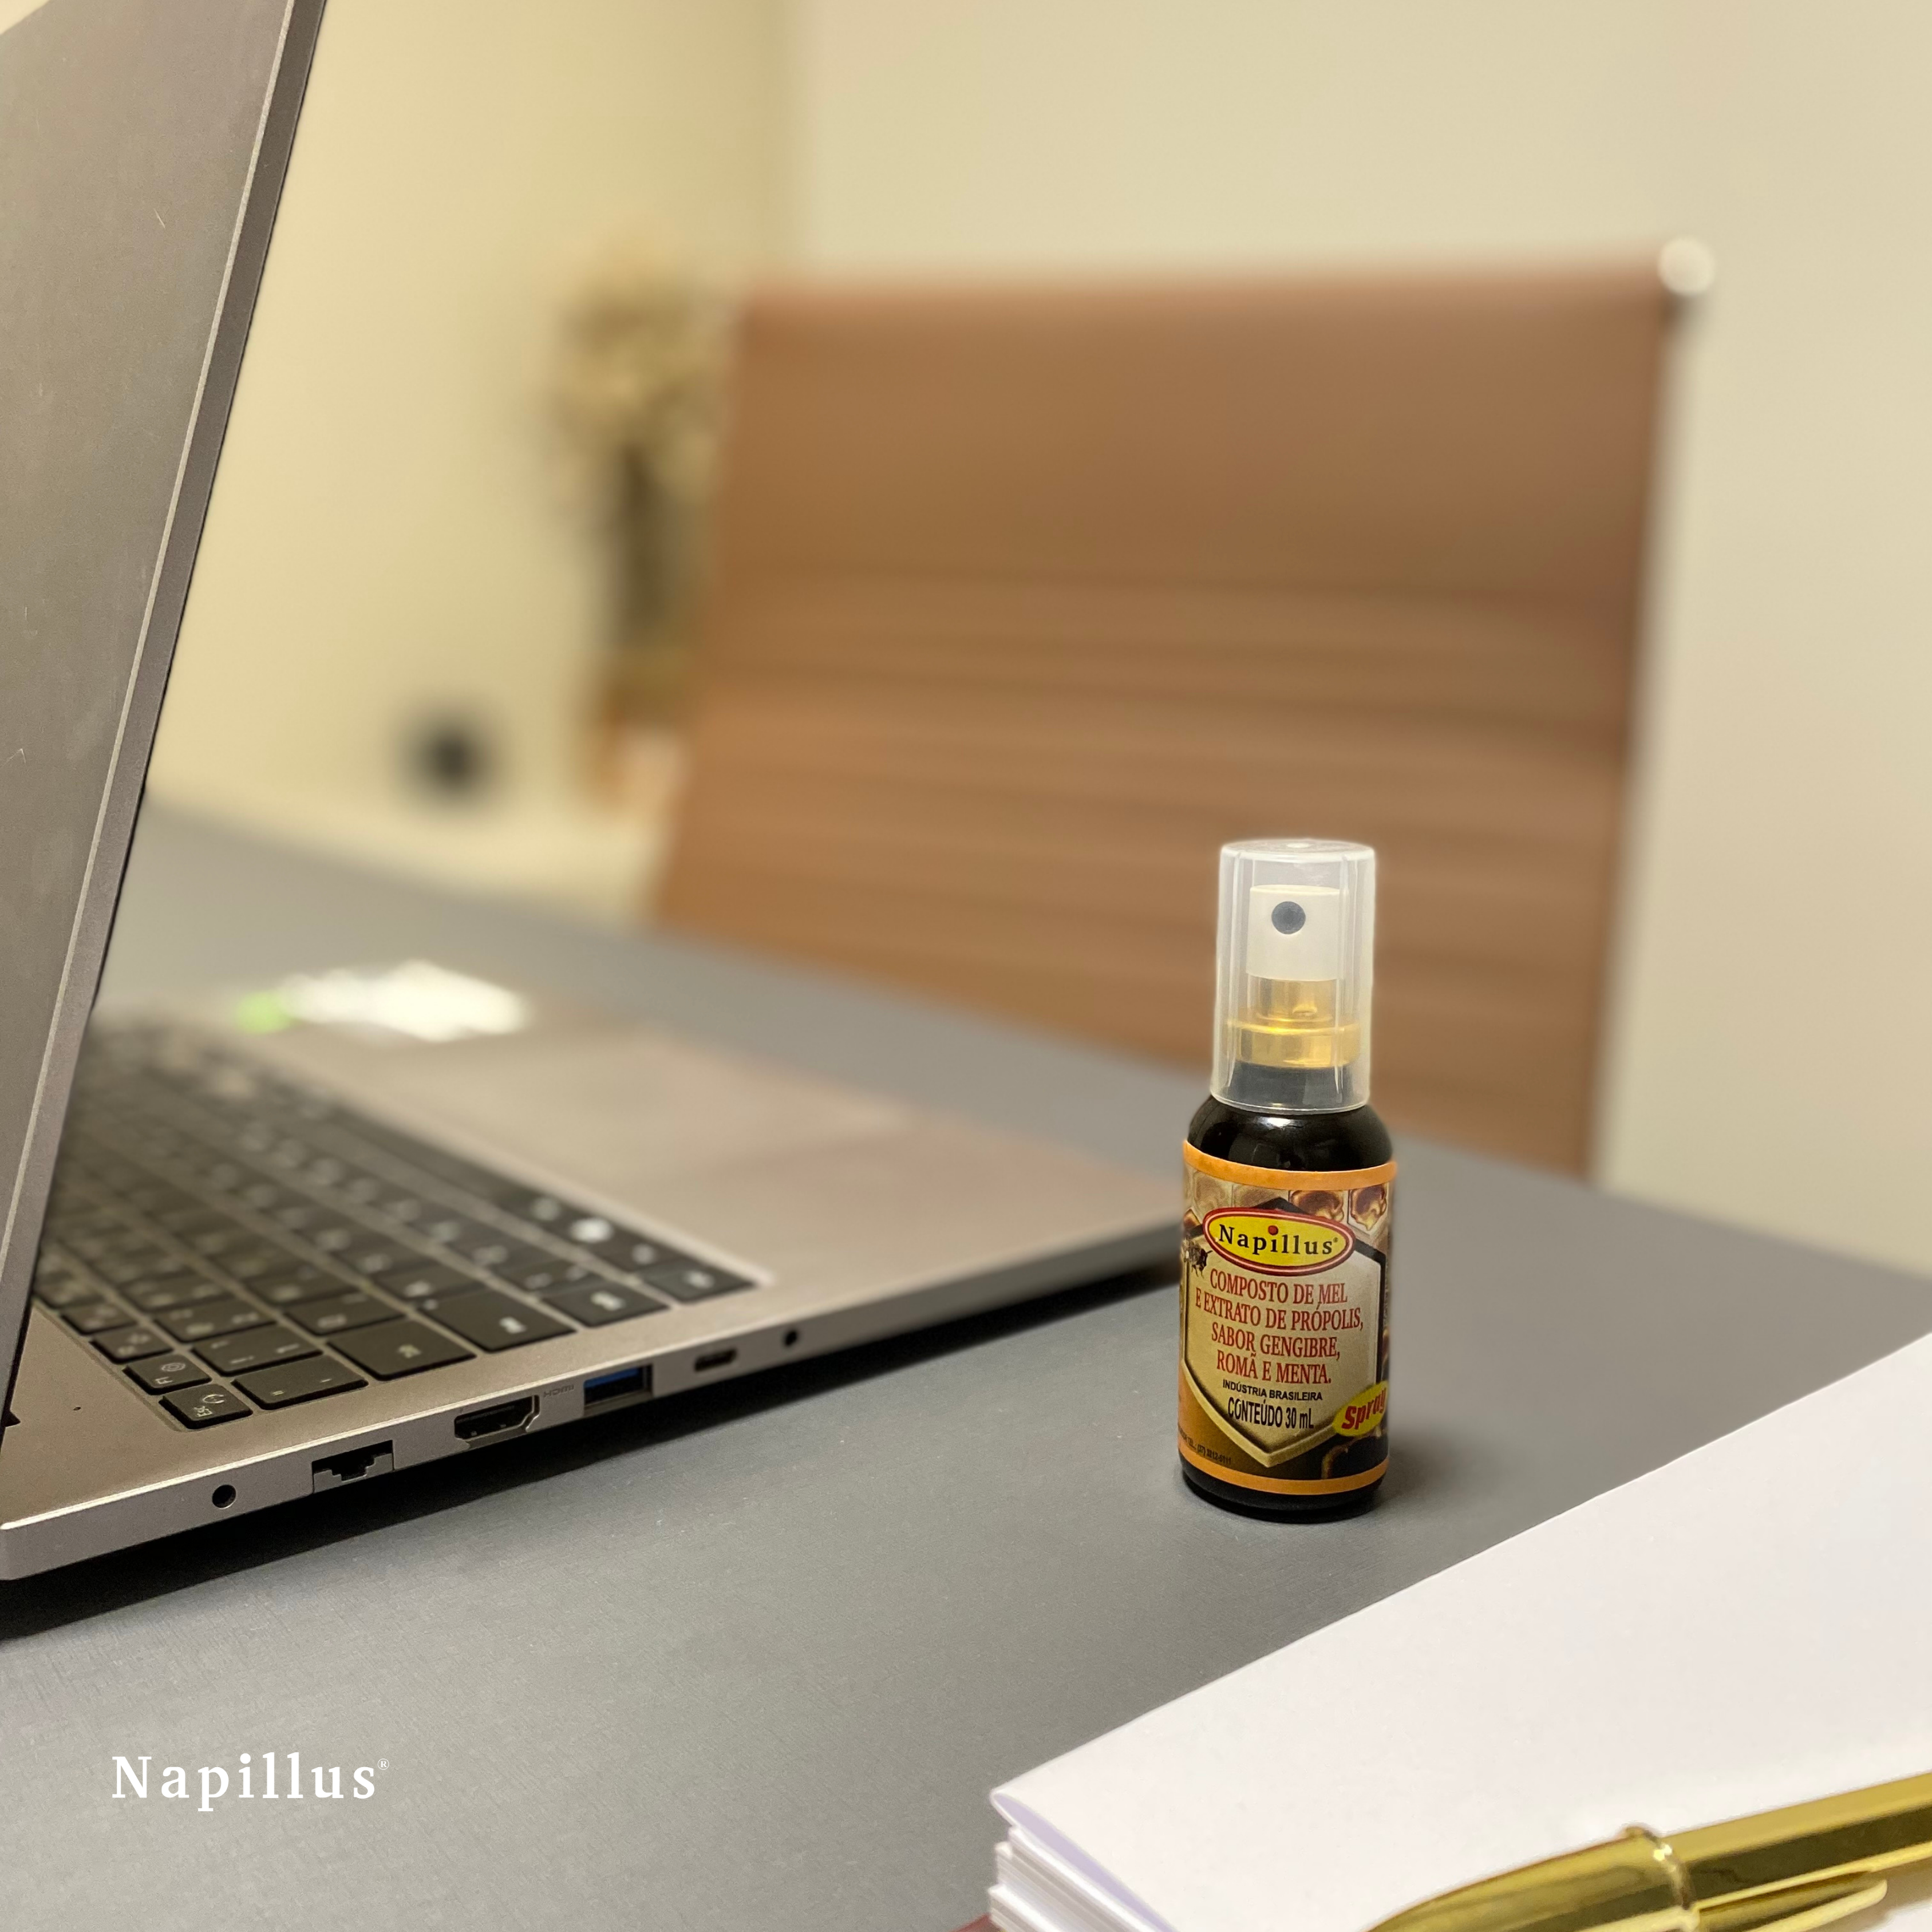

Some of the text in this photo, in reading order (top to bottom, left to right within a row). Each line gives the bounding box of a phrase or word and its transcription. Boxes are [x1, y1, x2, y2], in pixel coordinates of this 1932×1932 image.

[1210, 1268, 1348, 1305] COMPOSTO DE MEL
[1196, 1287, 1364, 1332] E EXTRATO DE PRÓPOLIS,
[1212, 1322, 1340, 1361] SABOR GENGIBRE,
[1217, 1349, 1332, 1384] ROMÃ E MENTA.
[1223, 1379, 1323, 1401] INDÚSTRIA BRASILEIRA
[1227, 1397, 1314, 1429] CONTEÚDO 30 mL
